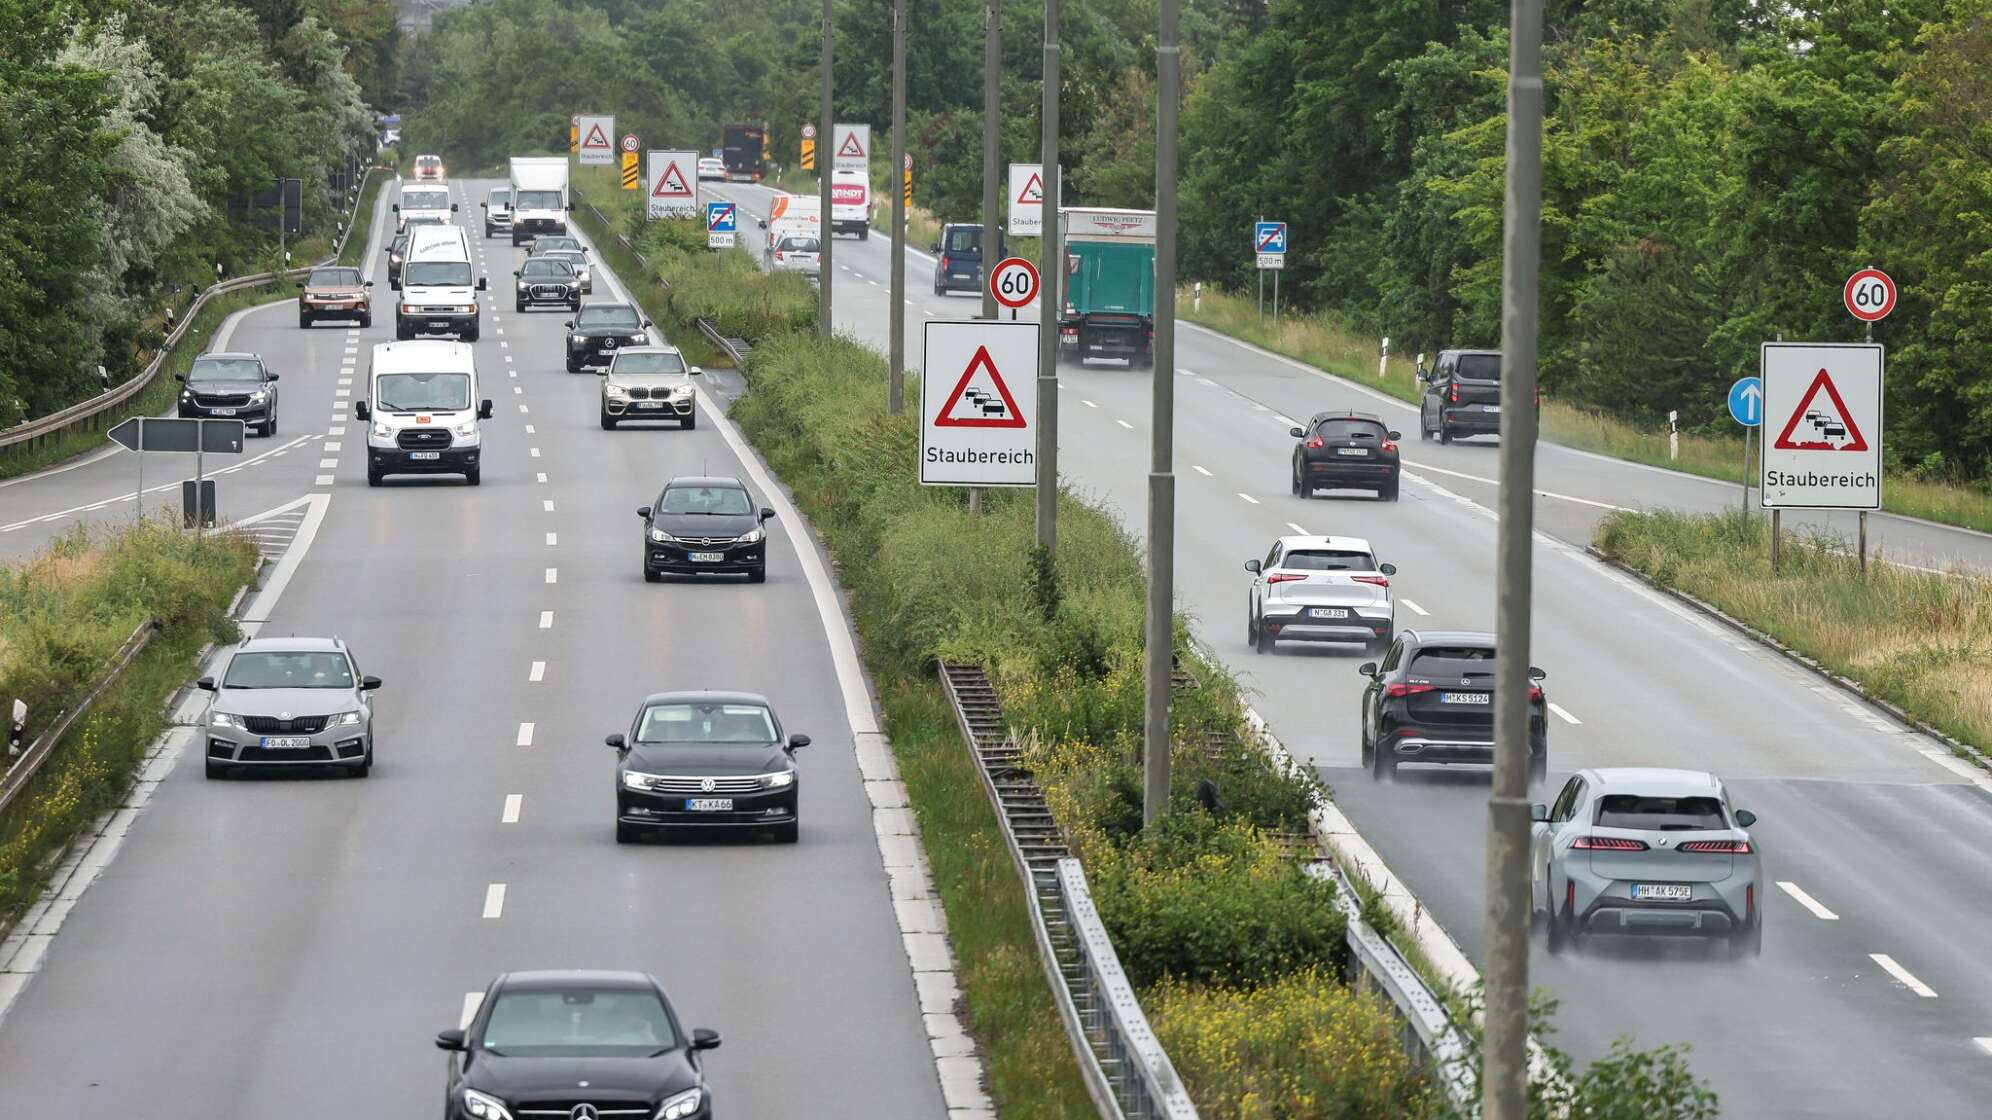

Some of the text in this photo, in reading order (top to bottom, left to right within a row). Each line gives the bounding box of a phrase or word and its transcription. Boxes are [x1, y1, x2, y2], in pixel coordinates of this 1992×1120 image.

[625, 139, 636, 148] 60
[651, 203, 696, 213] Staubereich
[711, 236, 725, 244] 500
[1259, 257, 1273, 265] 500
[1001, 272, 1029, 294] 60
[1855, 283, 1885, 306] 60
[926, 446, 1034, 466] Staubereich
[1767, 470, 1876, 488] Staubereich
